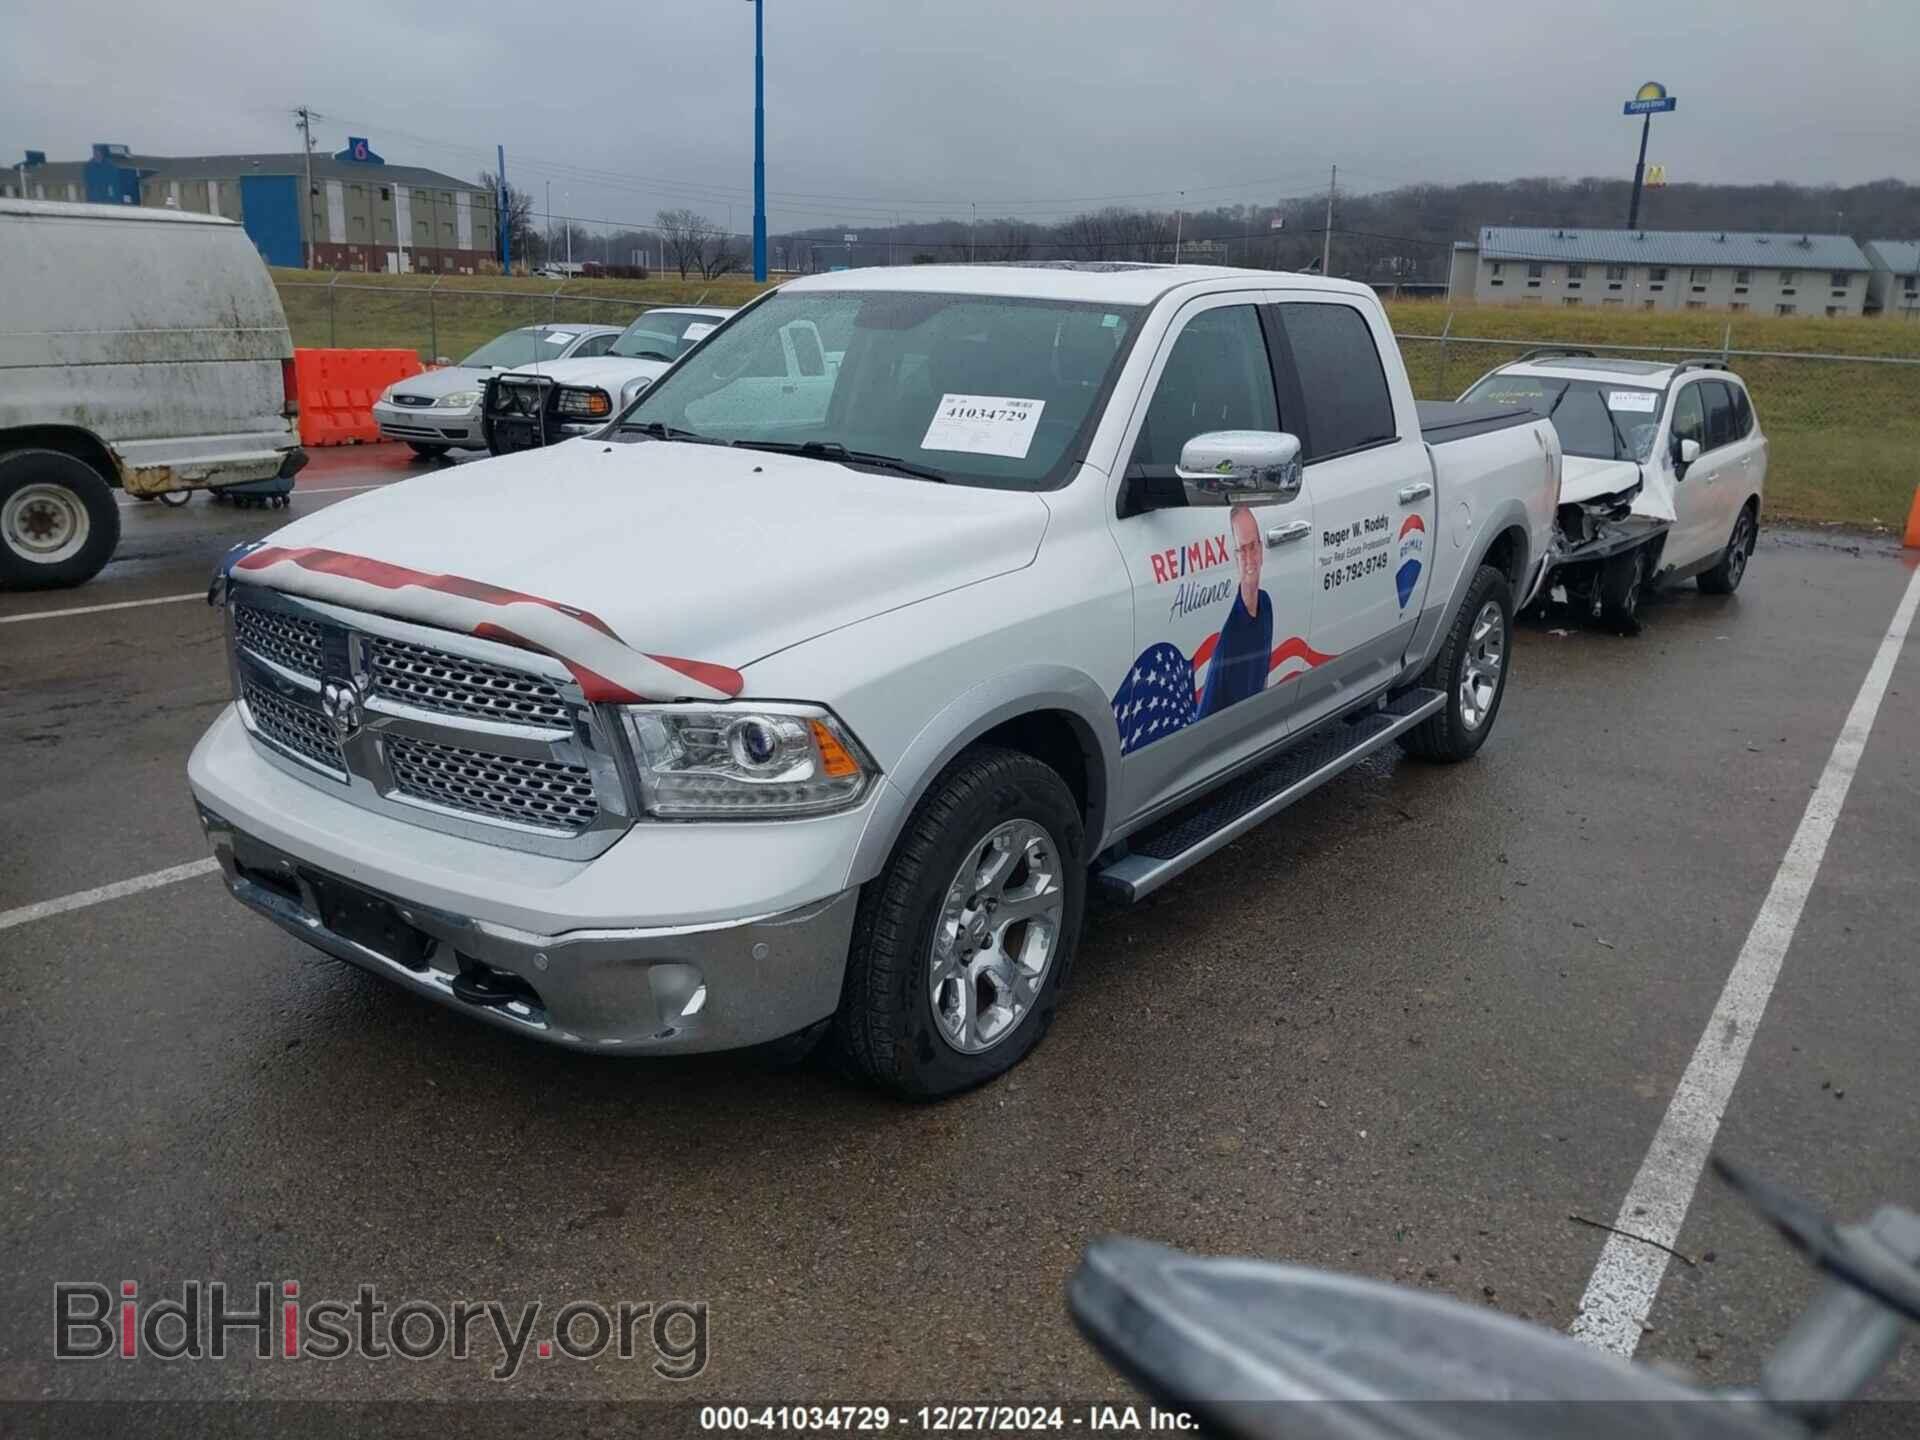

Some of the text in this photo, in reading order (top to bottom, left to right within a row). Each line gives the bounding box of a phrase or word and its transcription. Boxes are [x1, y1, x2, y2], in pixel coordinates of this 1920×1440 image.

[355, 143, 367, 160] 6
[945, 407, 1028, 422] 41034729
[1323, 514, 1389, 547] Roger W. Roddy
[1150, 534, 1230, 585] RE/MAX
[1323, 552, 1387, 590] 618-792-9749
[1168, 578, 1232, 623] Alliance
